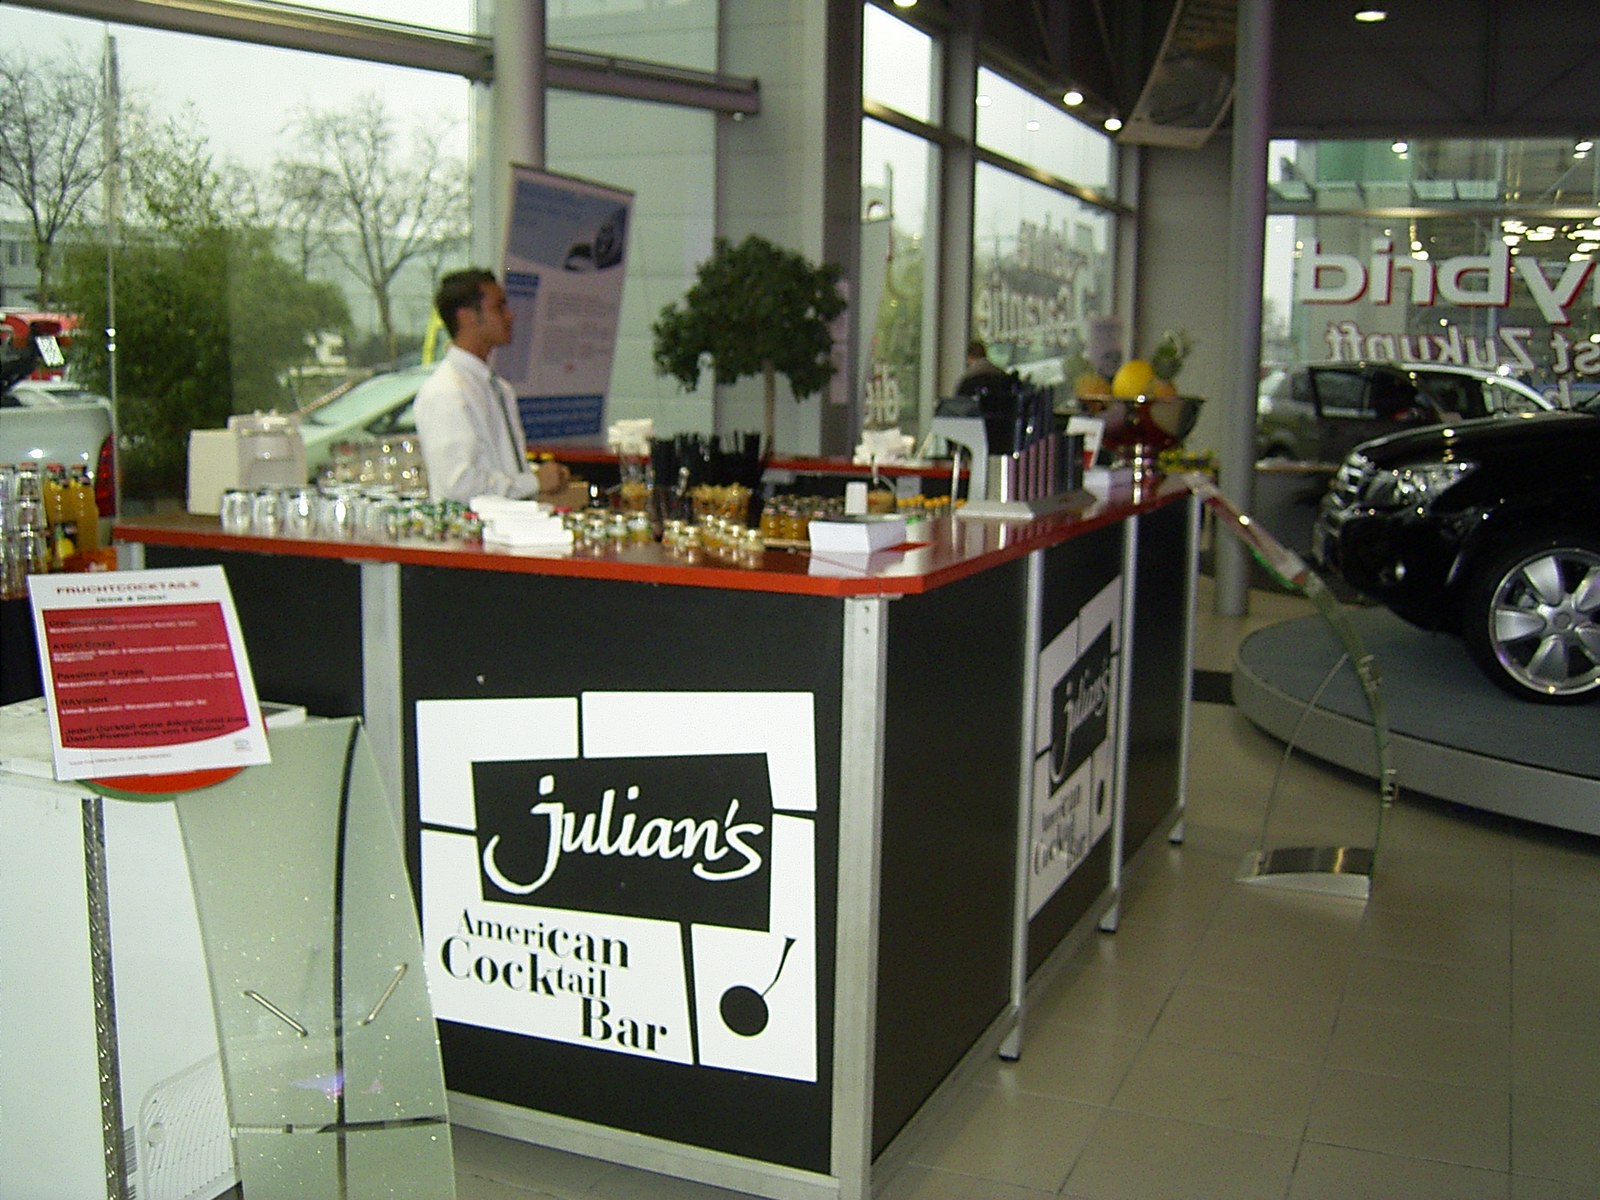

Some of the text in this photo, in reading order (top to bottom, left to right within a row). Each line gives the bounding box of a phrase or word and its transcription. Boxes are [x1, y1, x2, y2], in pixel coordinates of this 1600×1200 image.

[483, 775, 764, 895] julian's
[440, 936, 607, 999] Cocktail
[458, 909, 629, 969] American
[580, 997, 668, 1052] Bar
